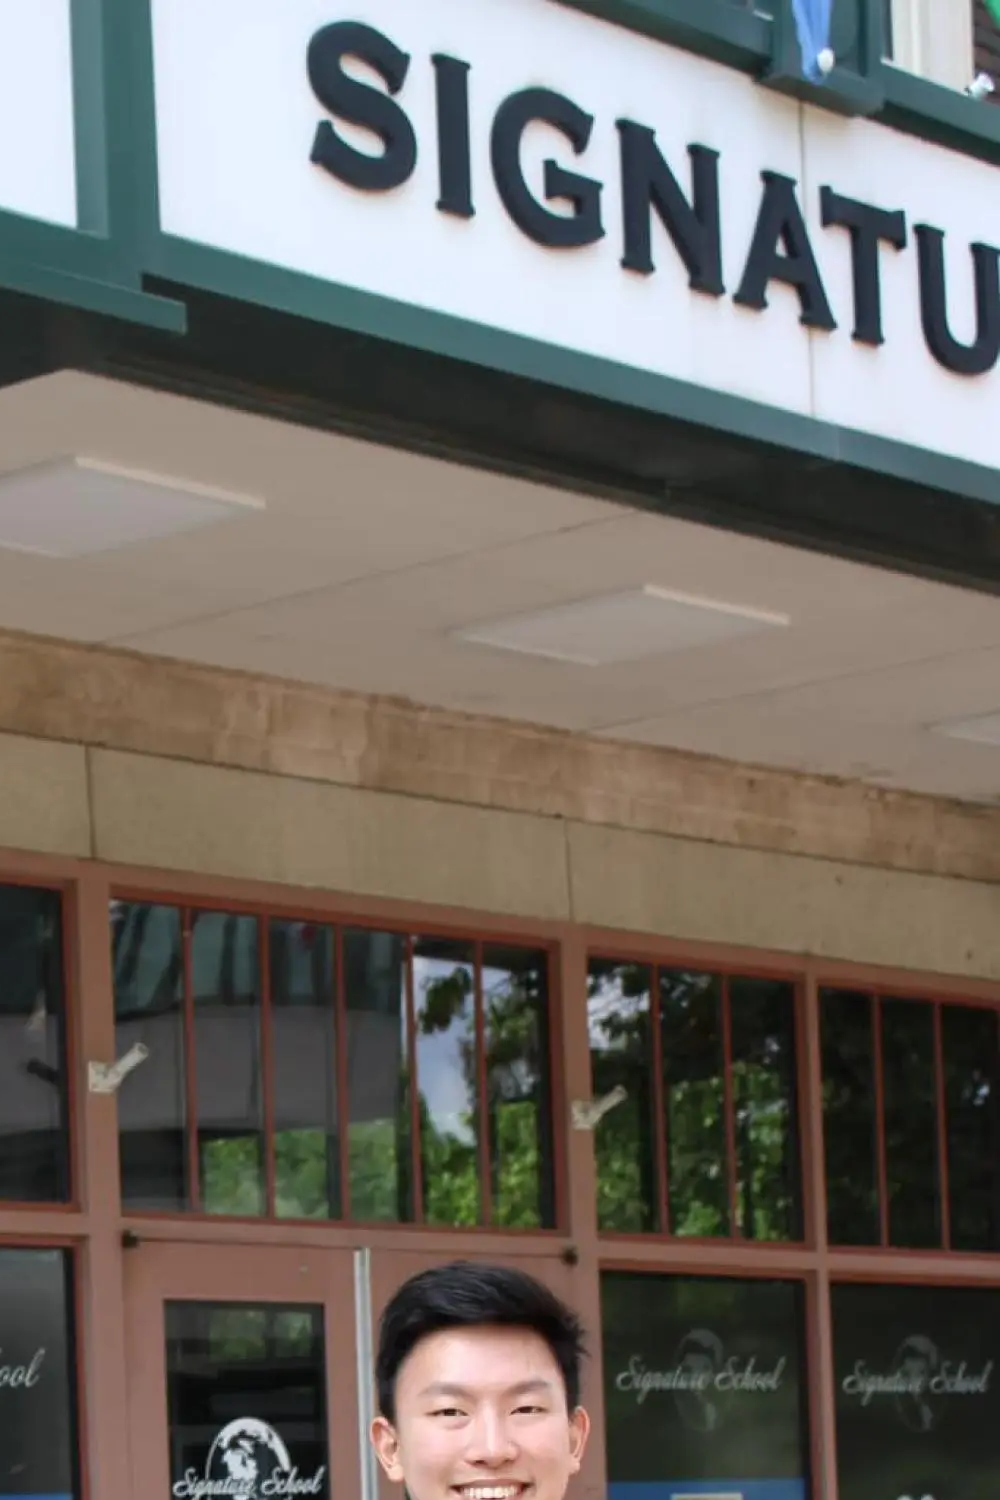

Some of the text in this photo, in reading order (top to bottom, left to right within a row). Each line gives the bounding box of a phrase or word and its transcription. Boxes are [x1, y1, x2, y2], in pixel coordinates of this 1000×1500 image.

[306, 20, 1000, 376] SIGNATU
[615, 1355, 787, 1404] Signature School
[261, 1465, 326, 1495] School
